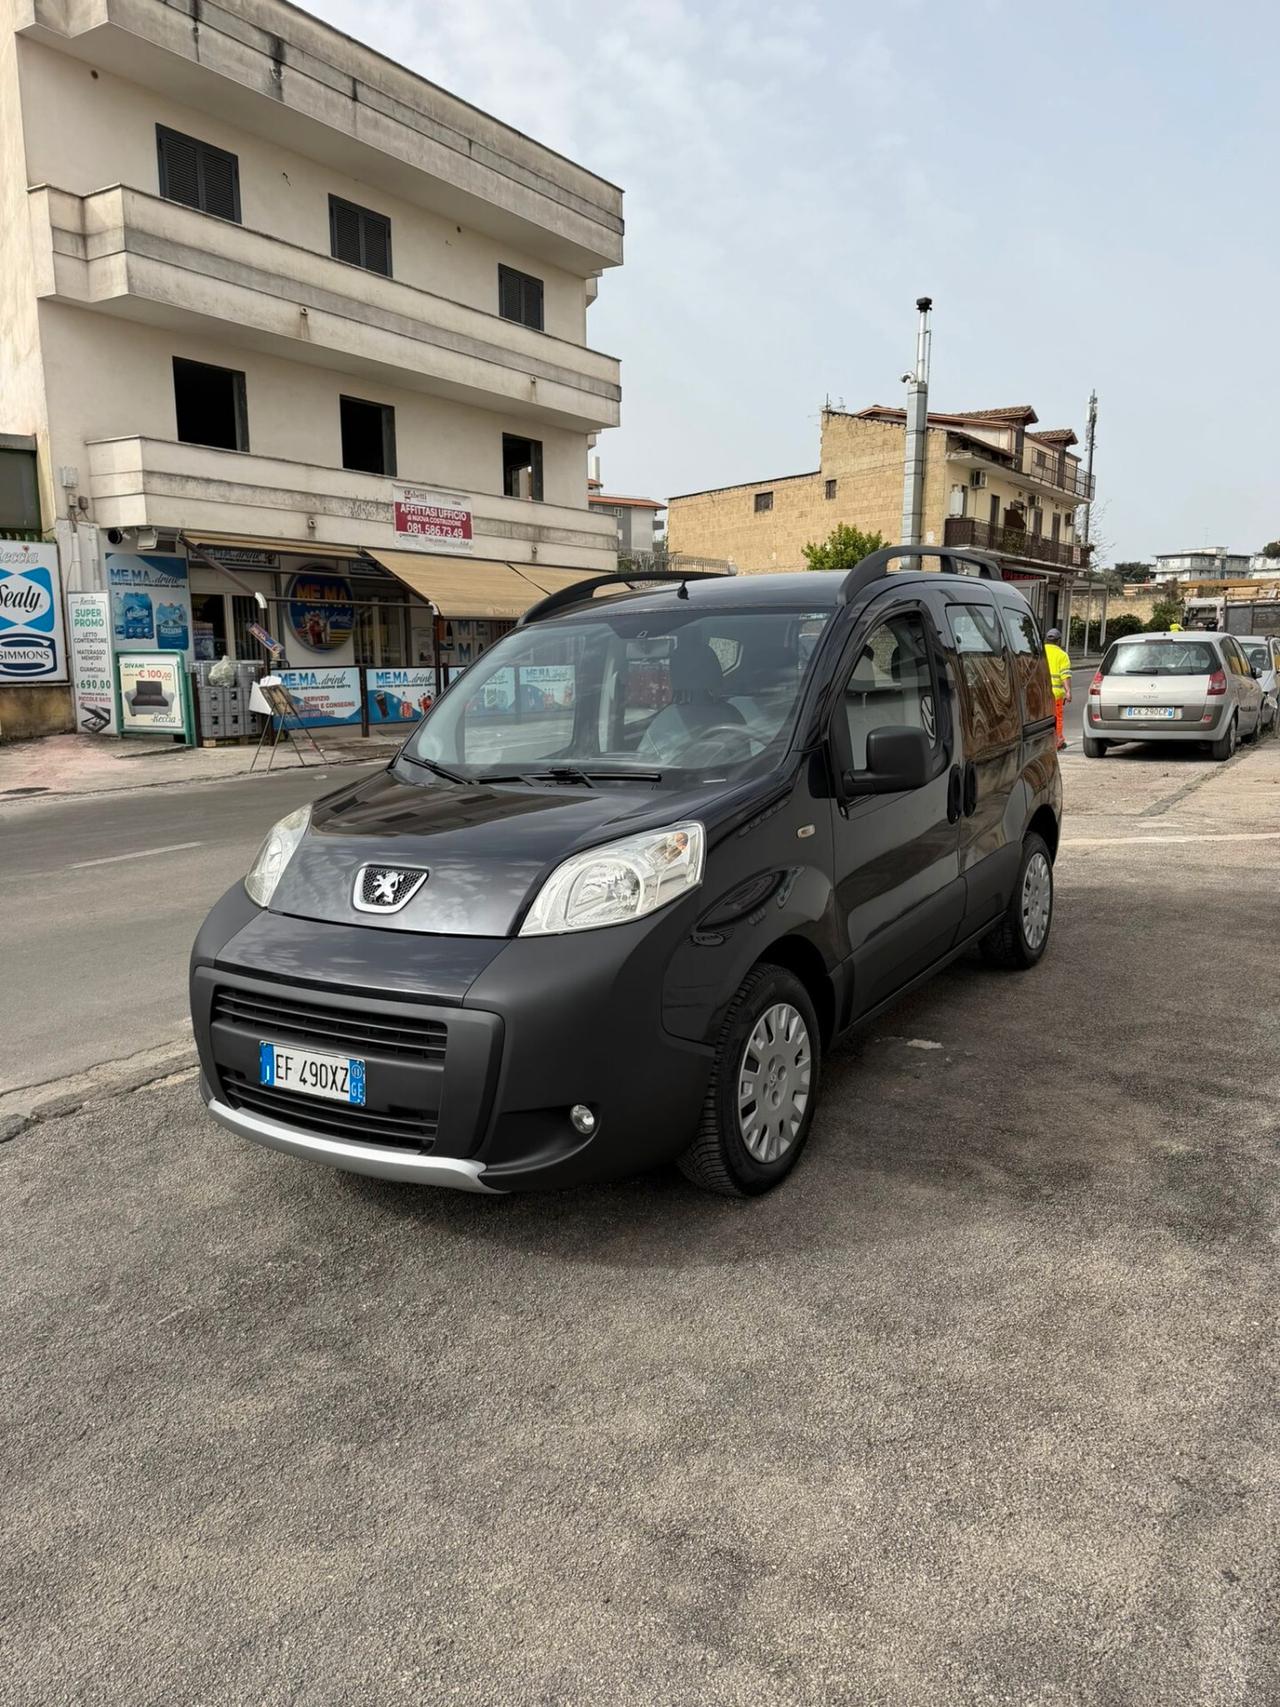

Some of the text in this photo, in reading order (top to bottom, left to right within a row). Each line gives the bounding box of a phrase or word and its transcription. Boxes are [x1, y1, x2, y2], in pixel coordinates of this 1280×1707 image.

[400, 504, 466, 521] AFFITTASI UFFICIO
[413, 515, 430, 523] NUOVA
[430, 517, 462, 527] COSTRUZIONE
[0, 584, 41, 613] Sealy
[75, 608, 102, 617] SUPER
[74, 618, 104, 627] PROMO
[276, 1054, 349, 1094] EF 490XZ
[351, 1082, 363, 1099] GE
